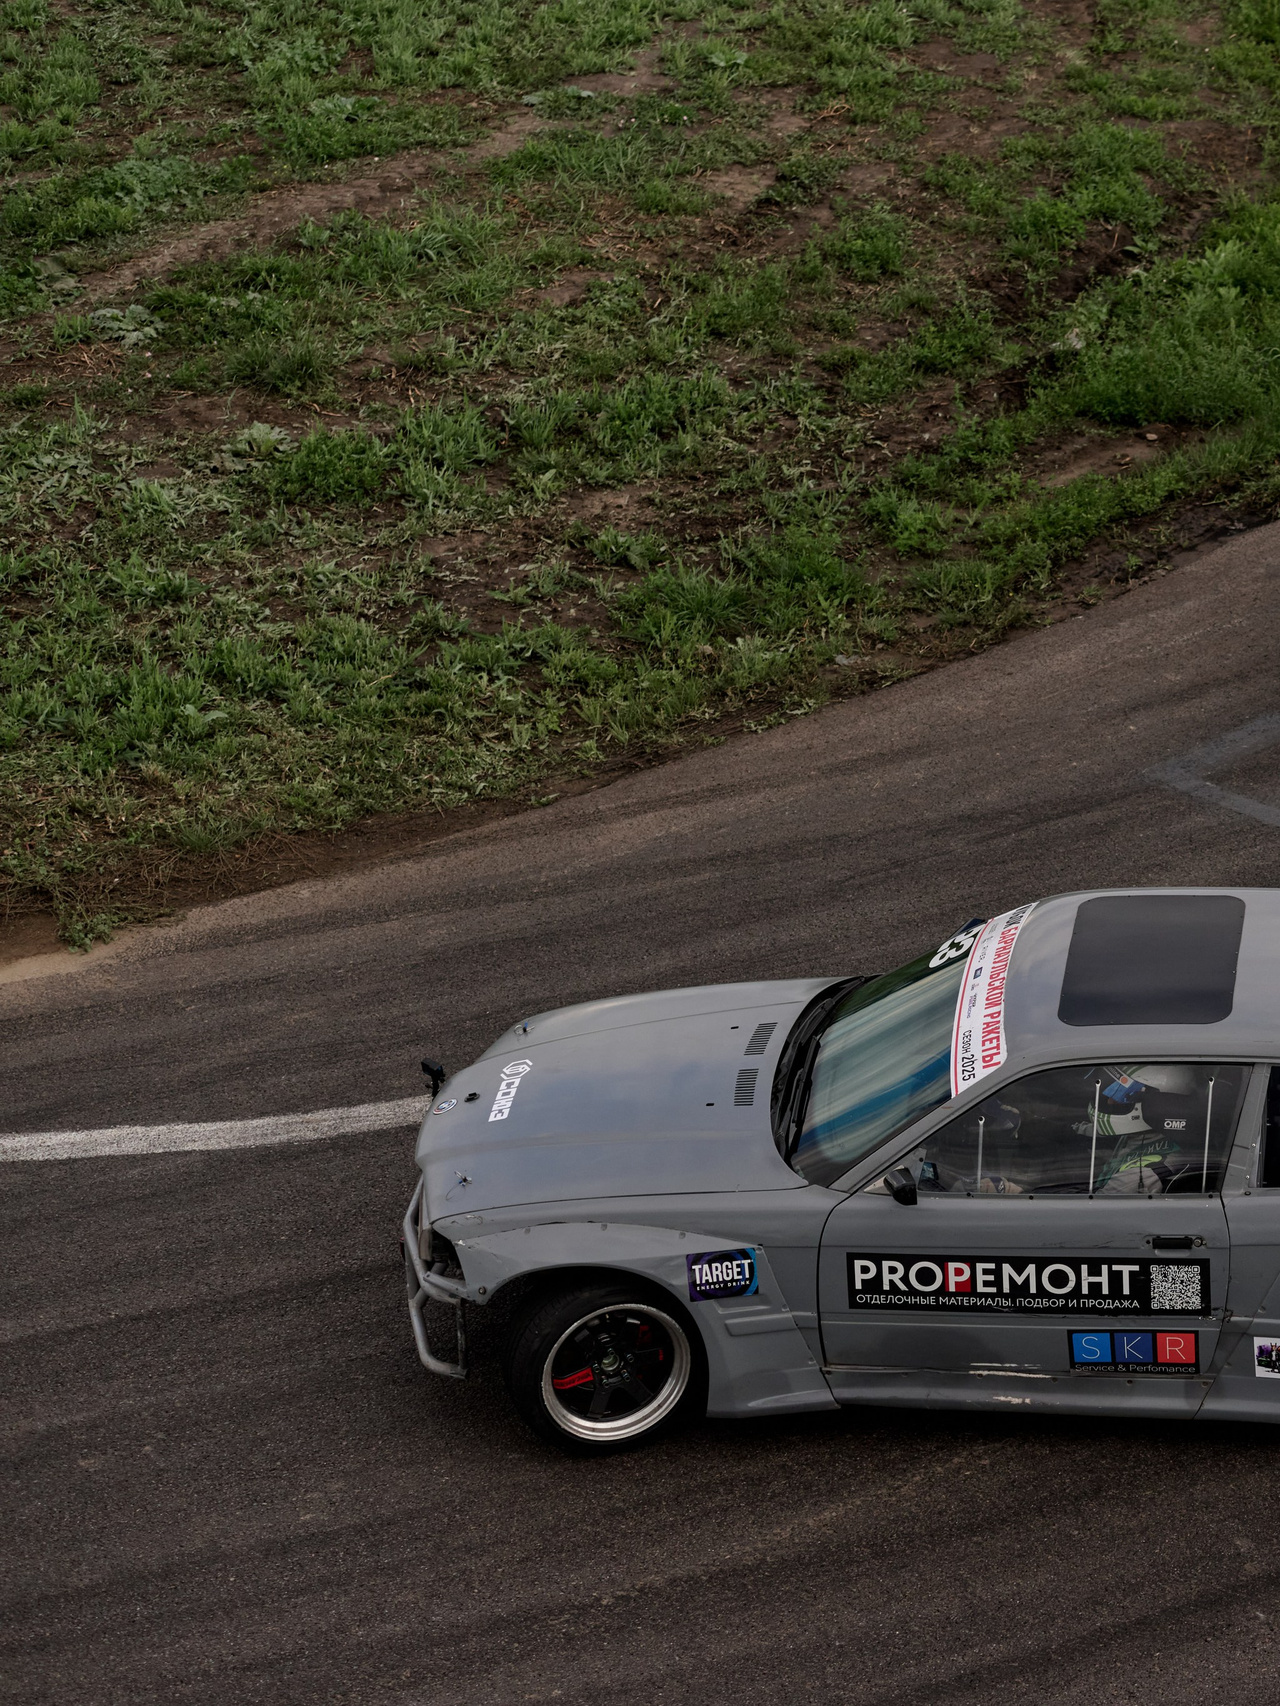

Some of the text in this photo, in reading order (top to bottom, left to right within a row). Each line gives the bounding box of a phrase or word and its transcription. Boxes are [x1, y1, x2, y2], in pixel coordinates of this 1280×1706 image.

[984, 926, 1019, 1010] БАРНАУЛЬСКОЙ
[981, 1010, 1001, 1069] РАКЕТЫ
[961, 1029, 976, 1082] СЕЗОН 2025
[488, 1078, 521, 1122] СОЮЗ
[1164, 1119, 1186, 1129] OMP
[692, 1259, 752, 1284] TARGET
[697, 1283, 724, 1291] ENERGY
[856, 1294, 936, 1305] ОТДЕЛОЧНЫЕ
[1016, 1298, 1066, 1308] ПОДБОР
[1069, 1299, 1077, 1308] И
[1080, 1299, 1140, 1309] ПРОДАЖА
[1075, 1364, 1115, 1372] Service
[1129, 1364, 1196, 1373] Perfomance
